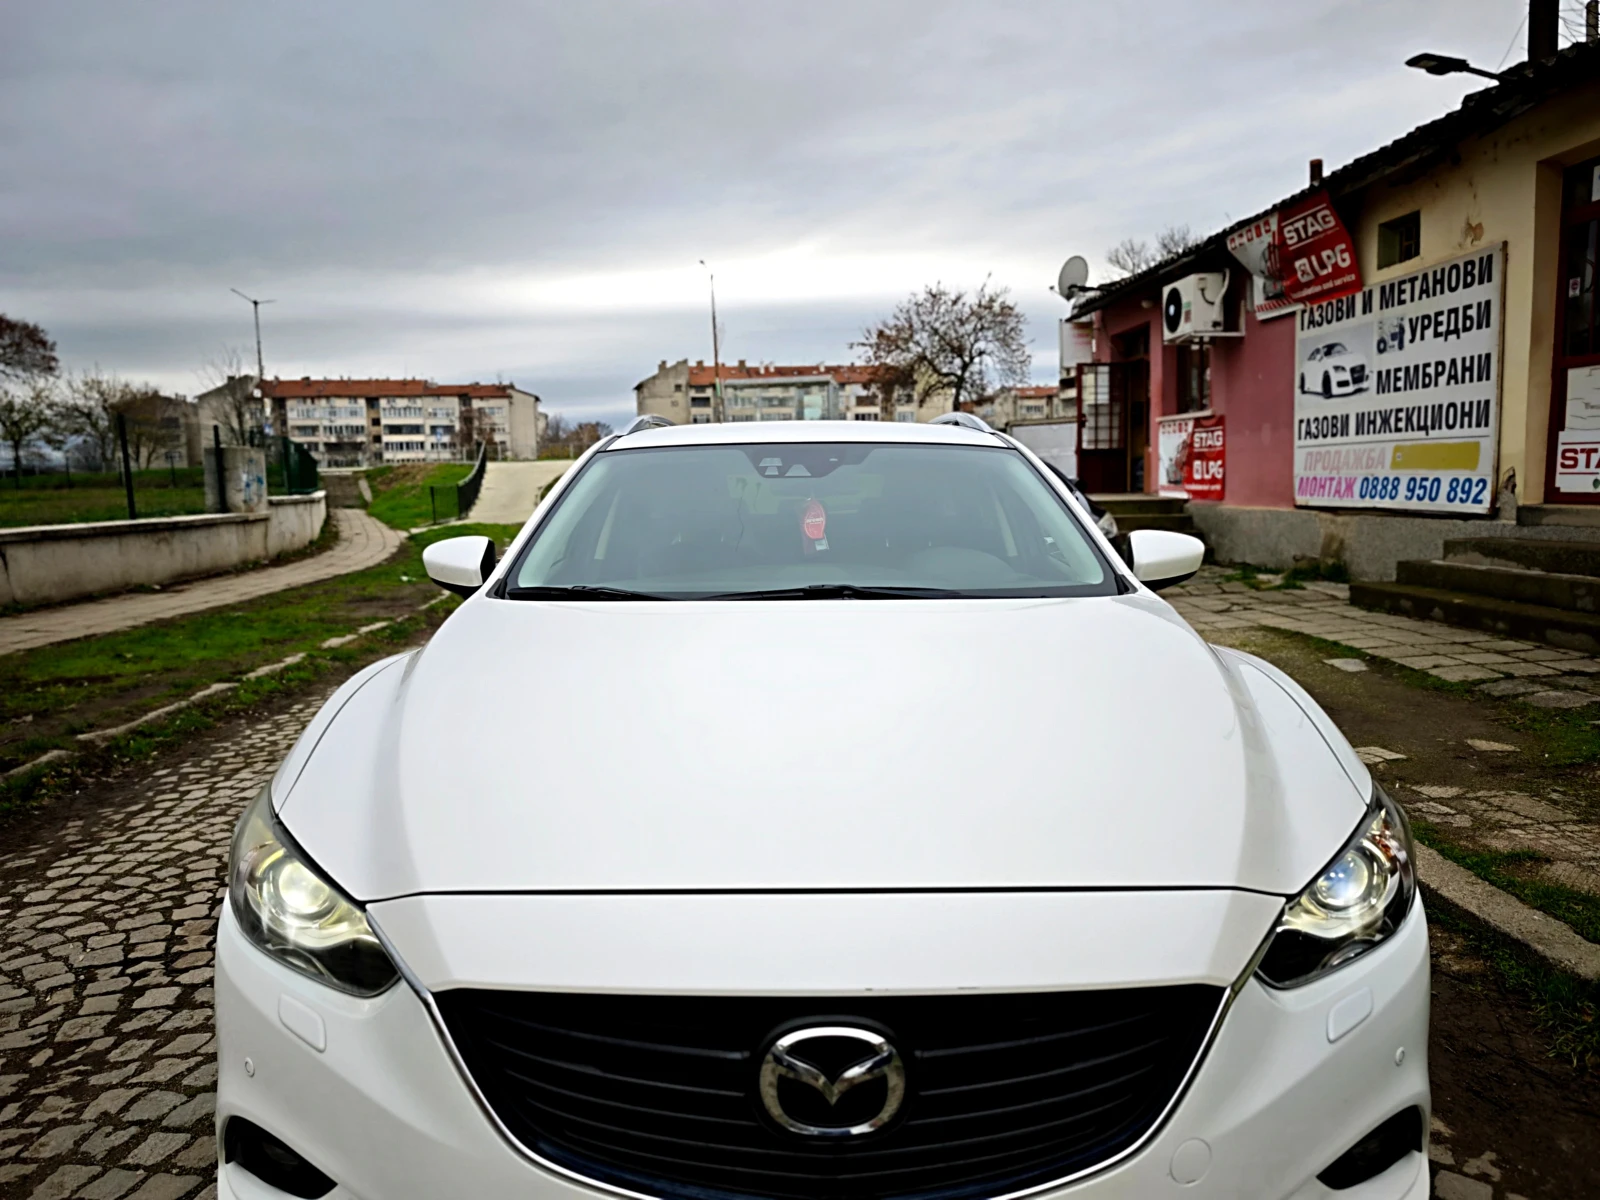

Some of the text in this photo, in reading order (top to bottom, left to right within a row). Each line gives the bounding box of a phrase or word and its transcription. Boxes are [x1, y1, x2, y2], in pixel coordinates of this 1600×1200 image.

[1283, 209, 1336, 245] STAG
[1311, 243, 1351, 276] LPG
[1300, 253, 1494, 331] ГАЗОВИ И МЕТАНОВИ
[1409, 299, 1492, 343] УРЕДБИ
[1376, 352, 1491, 395] МЕМБРАНИ
[1298, 399, 1491, 441] ГАЗОВИ ИНЖЕКЦИОНИ
[1193, 431, 1223, 447] STAG
[1203, 460, 1224, 479] LPG
[1303, 447, 1386, 474] ПРОДАЖБА
[1297, 476, 1487, 505] МОНТАЖ 0888 950 892
